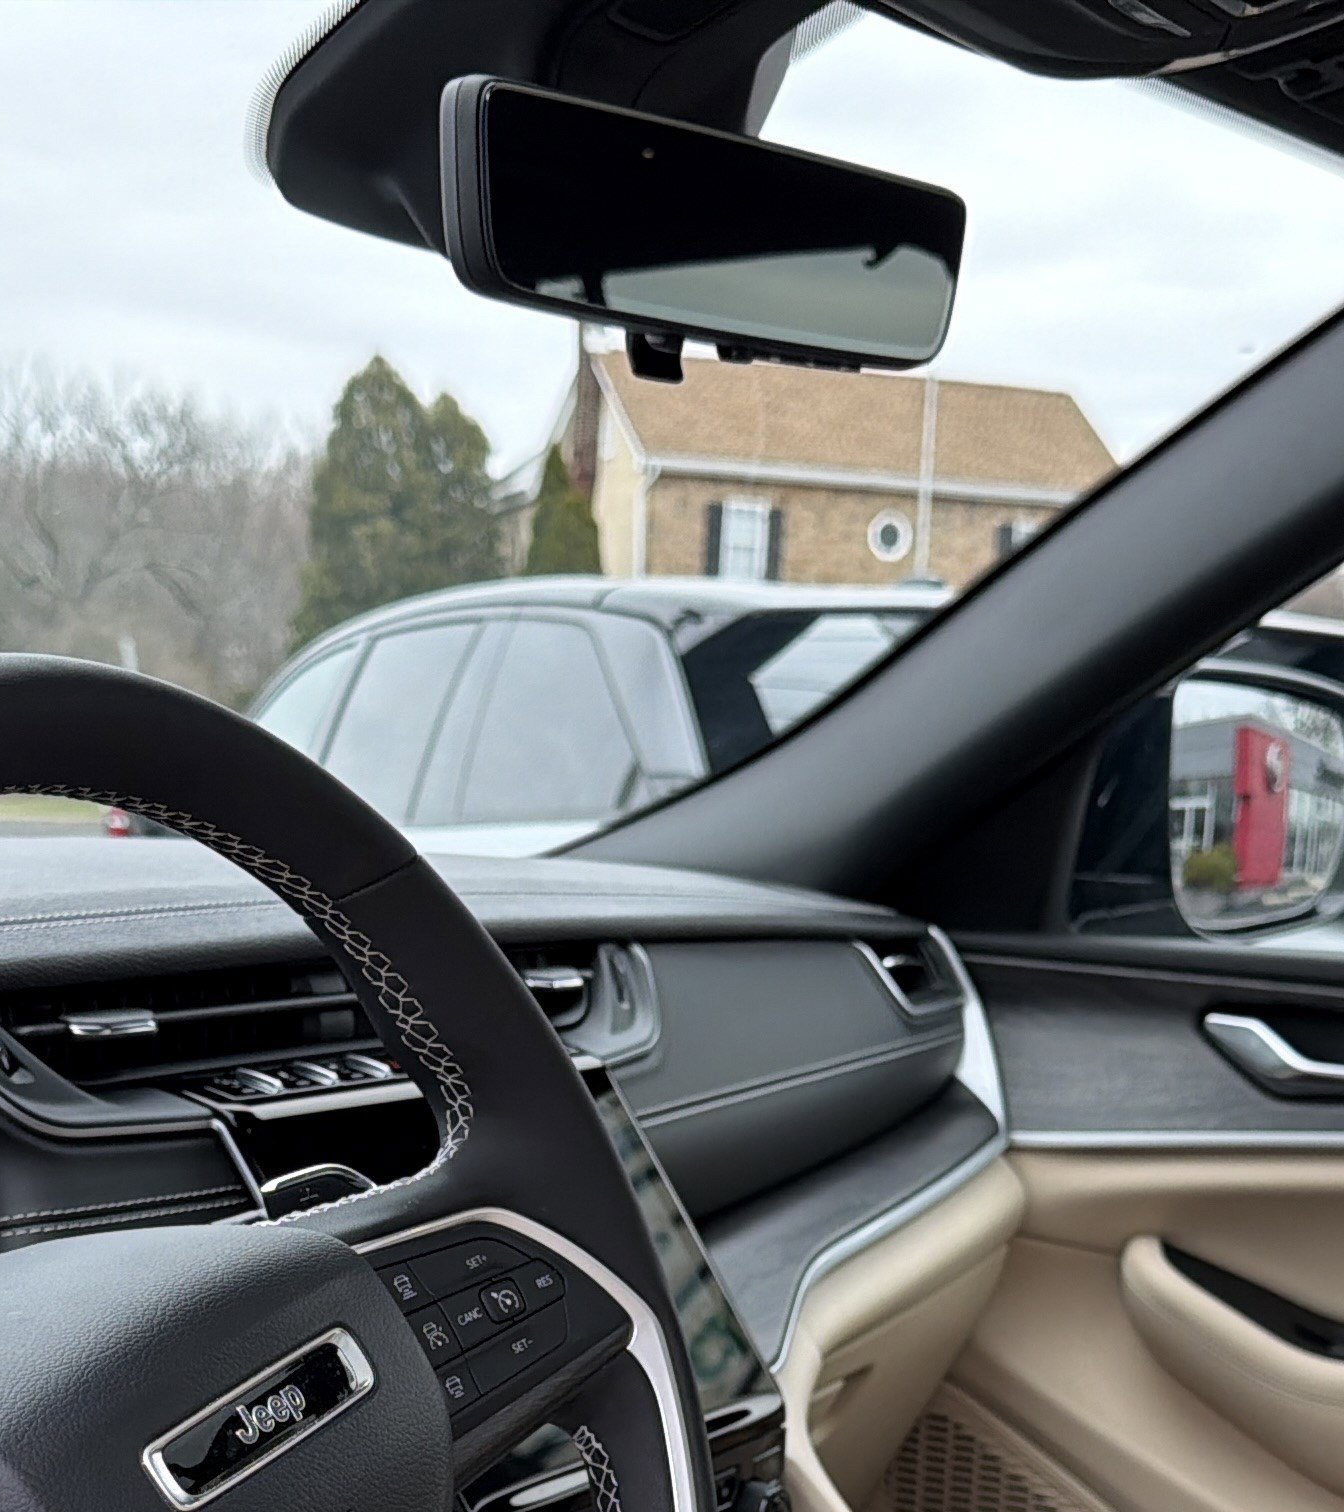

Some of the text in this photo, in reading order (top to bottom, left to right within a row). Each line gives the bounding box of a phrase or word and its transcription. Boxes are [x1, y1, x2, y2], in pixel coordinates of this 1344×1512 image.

[535, 1274, 553, 1288] RES
[457, 1307, 483, 1326] CANC
[235, 1384, 305, 1444] Jeep
